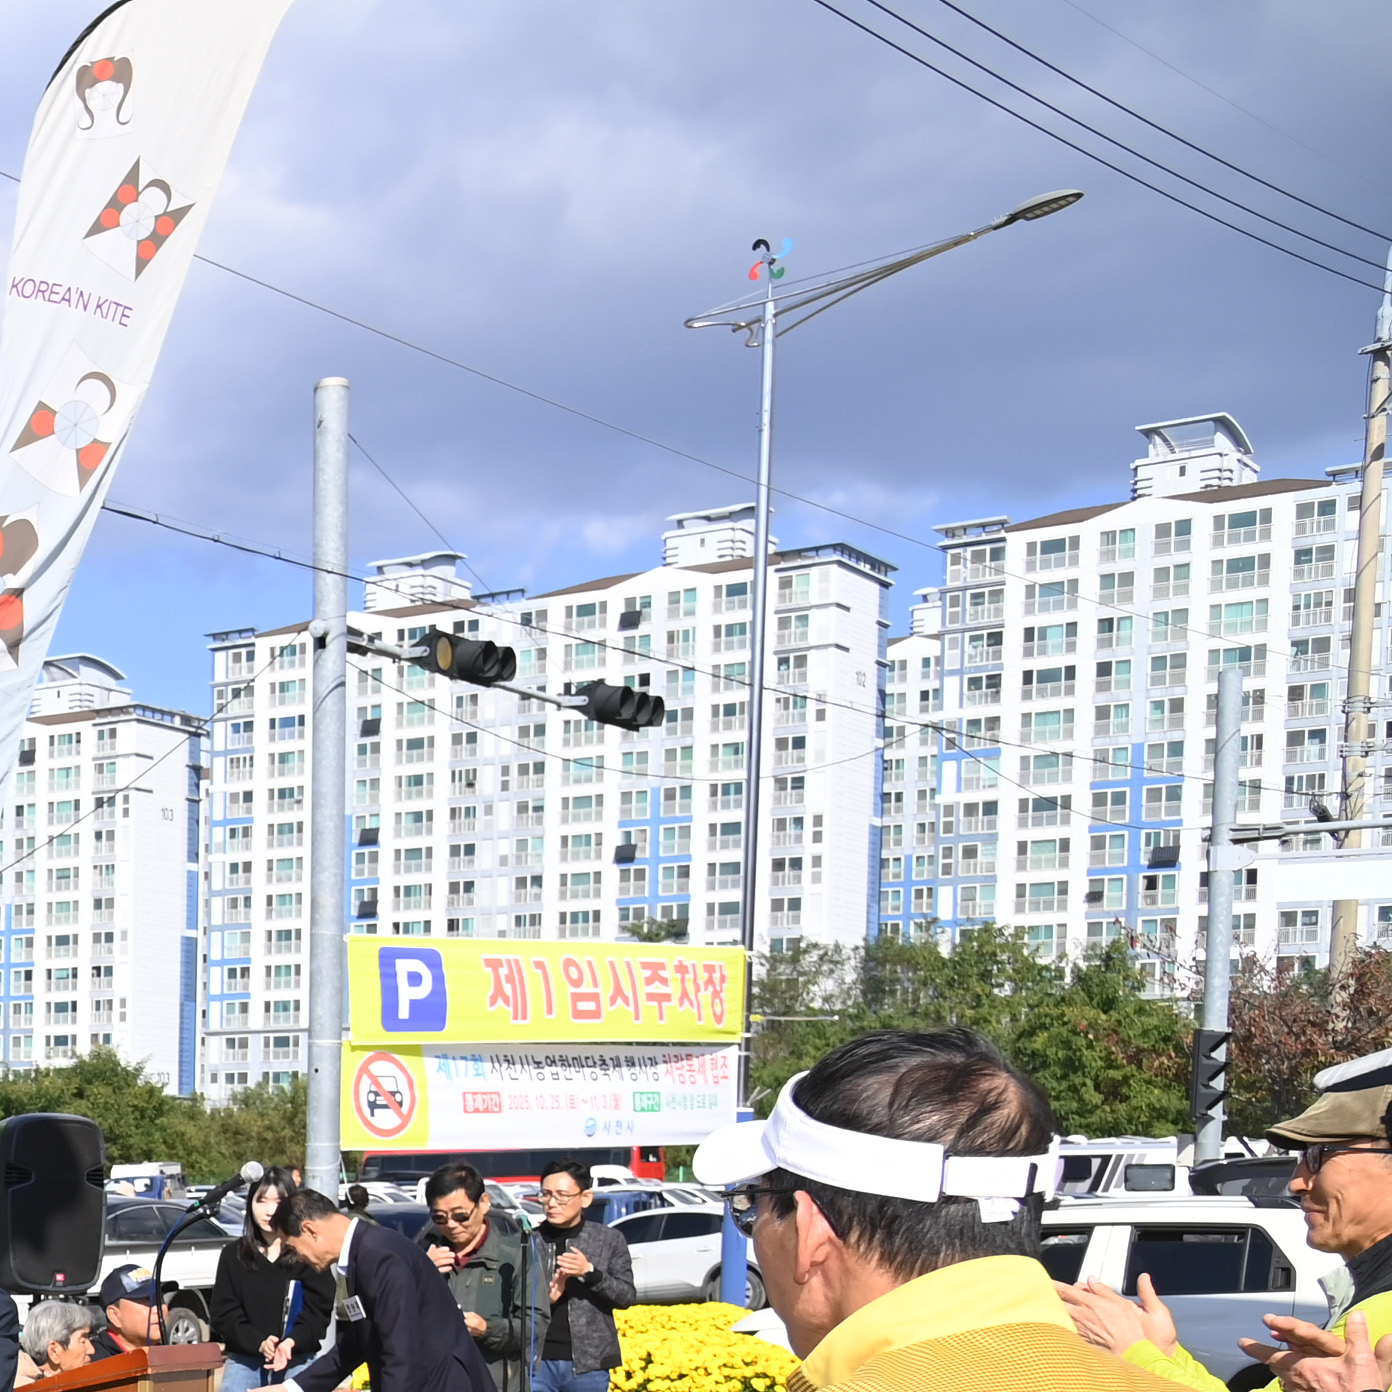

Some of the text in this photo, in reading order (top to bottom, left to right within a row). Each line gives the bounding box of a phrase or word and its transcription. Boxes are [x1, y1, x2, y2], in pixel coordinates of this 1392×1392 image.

[9, 276, 133, 328] KOREA'N KITE
[394, 958, 433, 1020] P
[434, 1053, 488, 1081] 제17회
